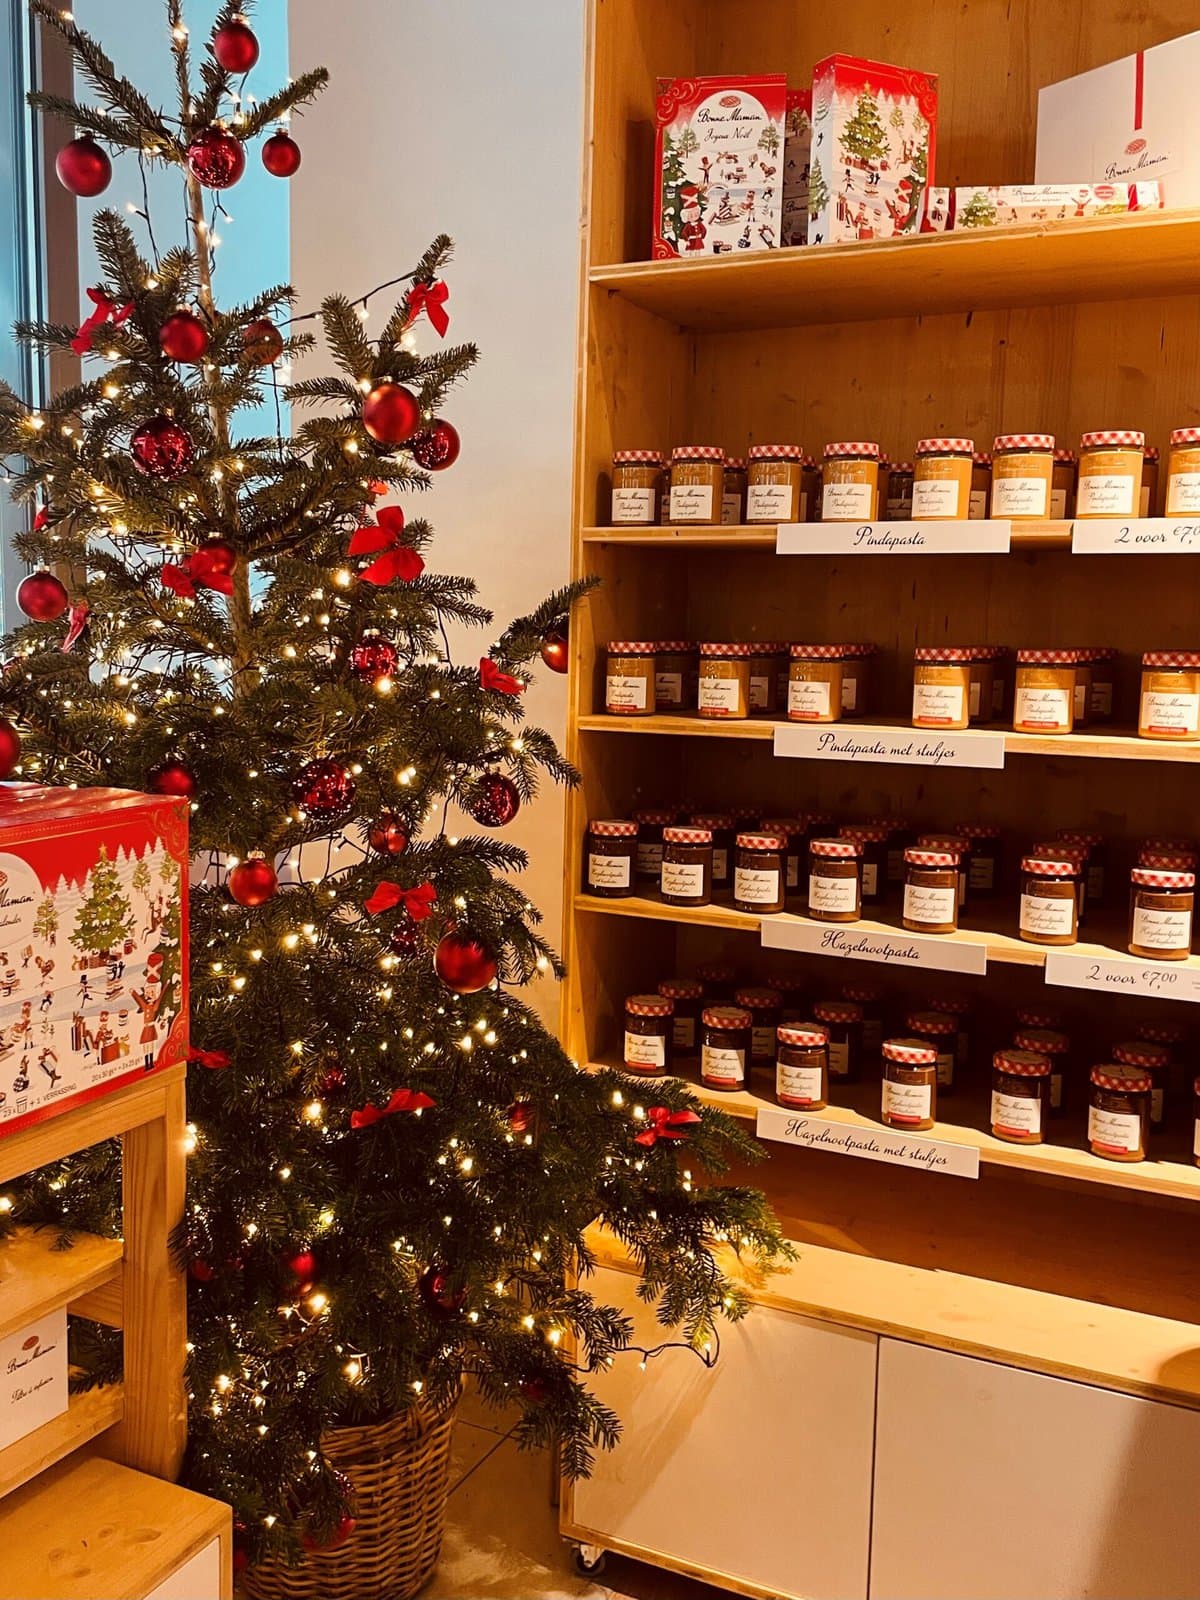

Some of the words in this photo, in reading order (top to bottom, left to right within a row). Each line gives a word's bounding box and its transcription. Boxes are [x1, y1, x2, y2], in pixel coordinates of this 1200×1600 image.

[697, 107, 725, 123] Bonne
[726, 107, 762, 122] Maman
[1104, 162, 1131, 181] Bonne
[1132, 151, 1169, 171] Maman
[852, 525, 926, 551] Pindapasta
[1114, 527, 1131, 544] 2
[1135, 533, 1167, 543] voor
[1172, 525, 1200, 545] €7,0
[816, 732, 887, 758] Pindapasta
[889, 741, 912, 757] met
[915, 740, 956, 765] stukjes
[820, 929, 921, 960] Hazelnootpasta
[1085, 964, 1100, 981] 2
[1105, 973, 1137, 985] voor
[1141, 969, 1178, 990] €7,00
[784, 1118, 880, 1152] Hazelnootpasta
[883, 1145, 906, 1158] met
[909, 1147, 949, 1169] stukjes
